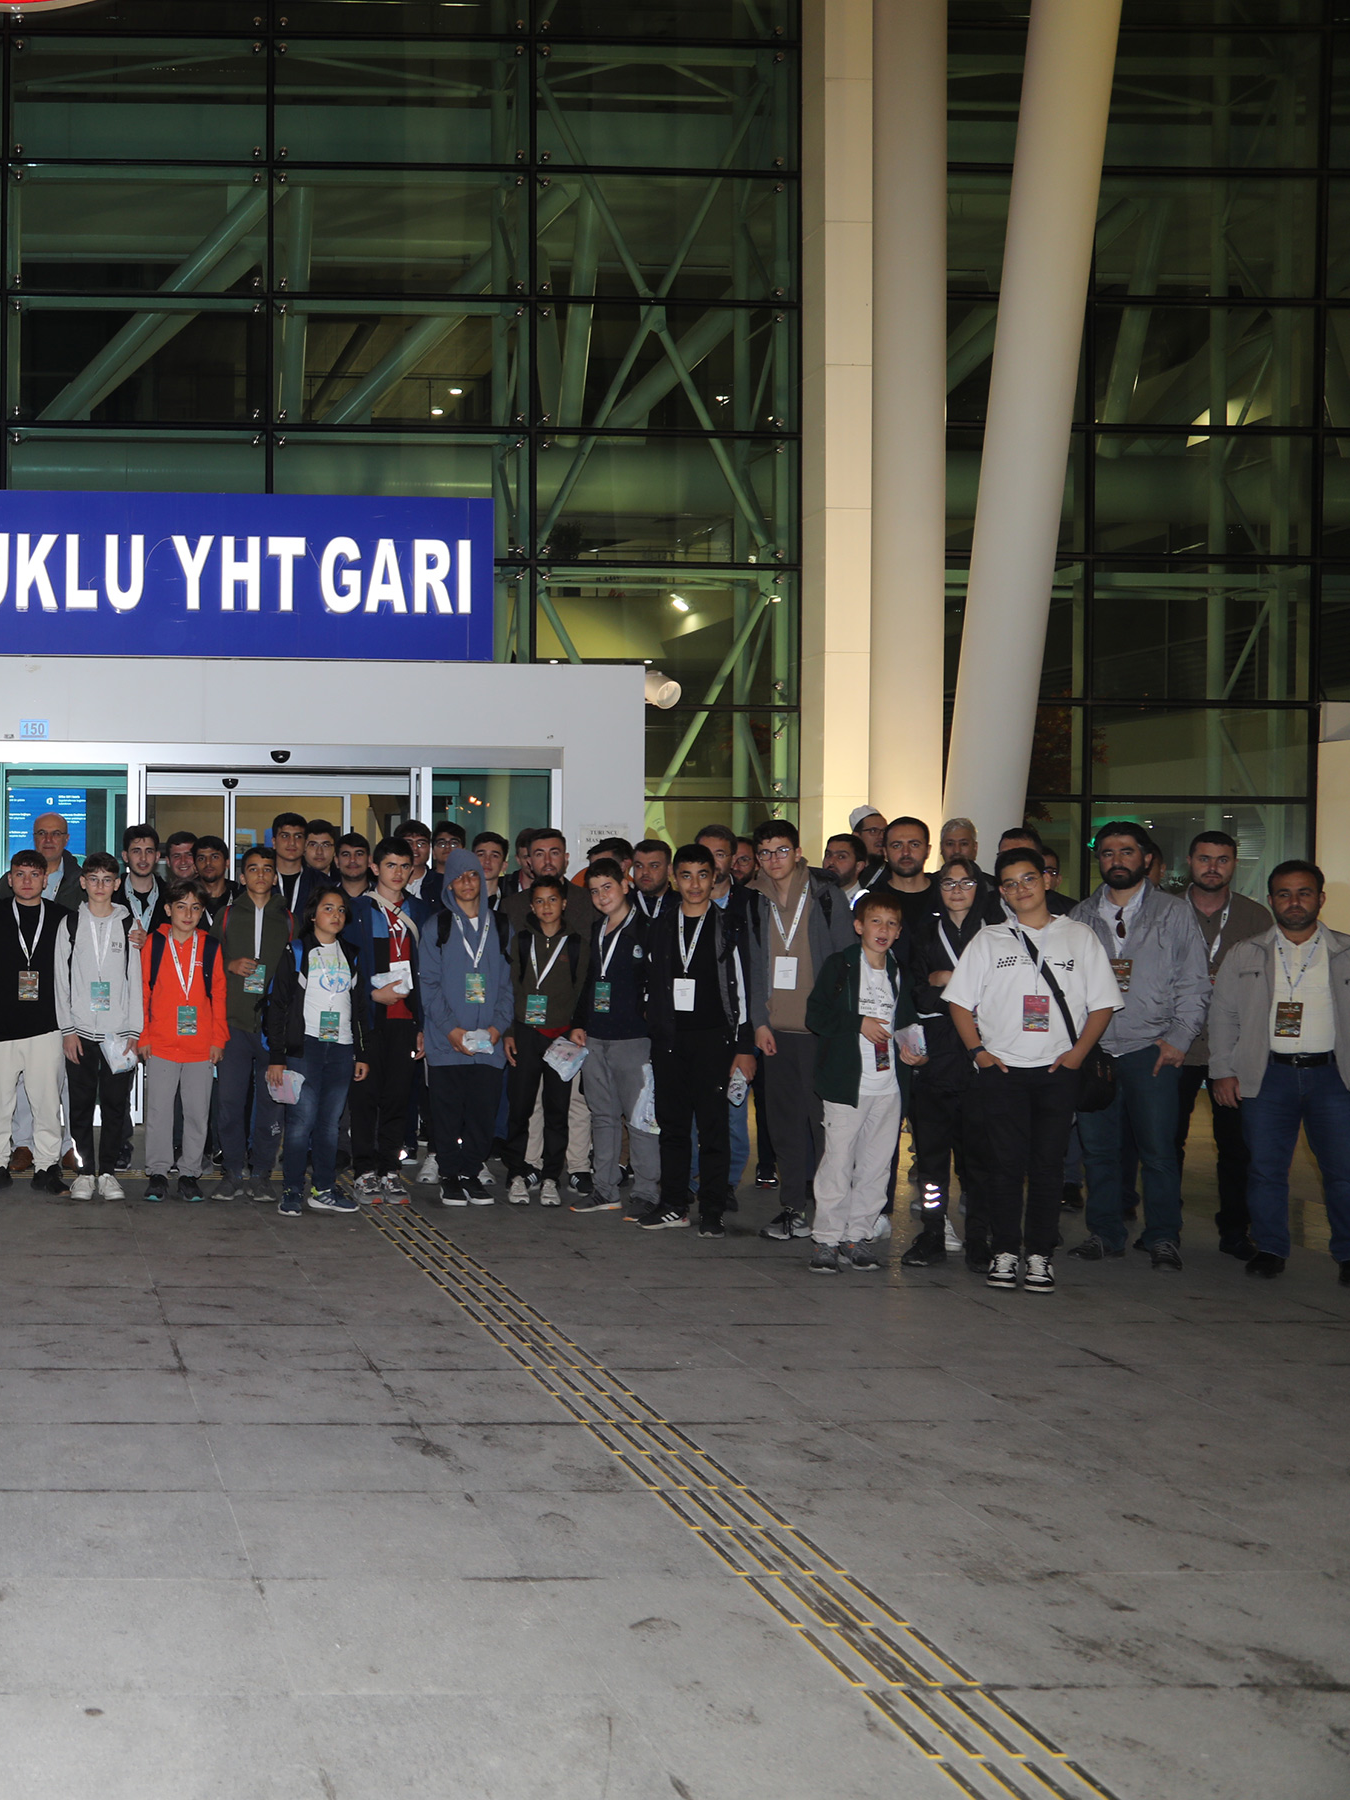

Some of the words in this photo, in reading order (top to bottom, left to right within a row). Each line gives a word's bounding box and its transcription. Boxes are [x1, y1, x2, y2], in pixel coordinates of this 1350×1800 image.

[171, 535, 306, 612] YHT
[319, 536, 471, 614] GARI
[23, 722, 45, 736] 150
